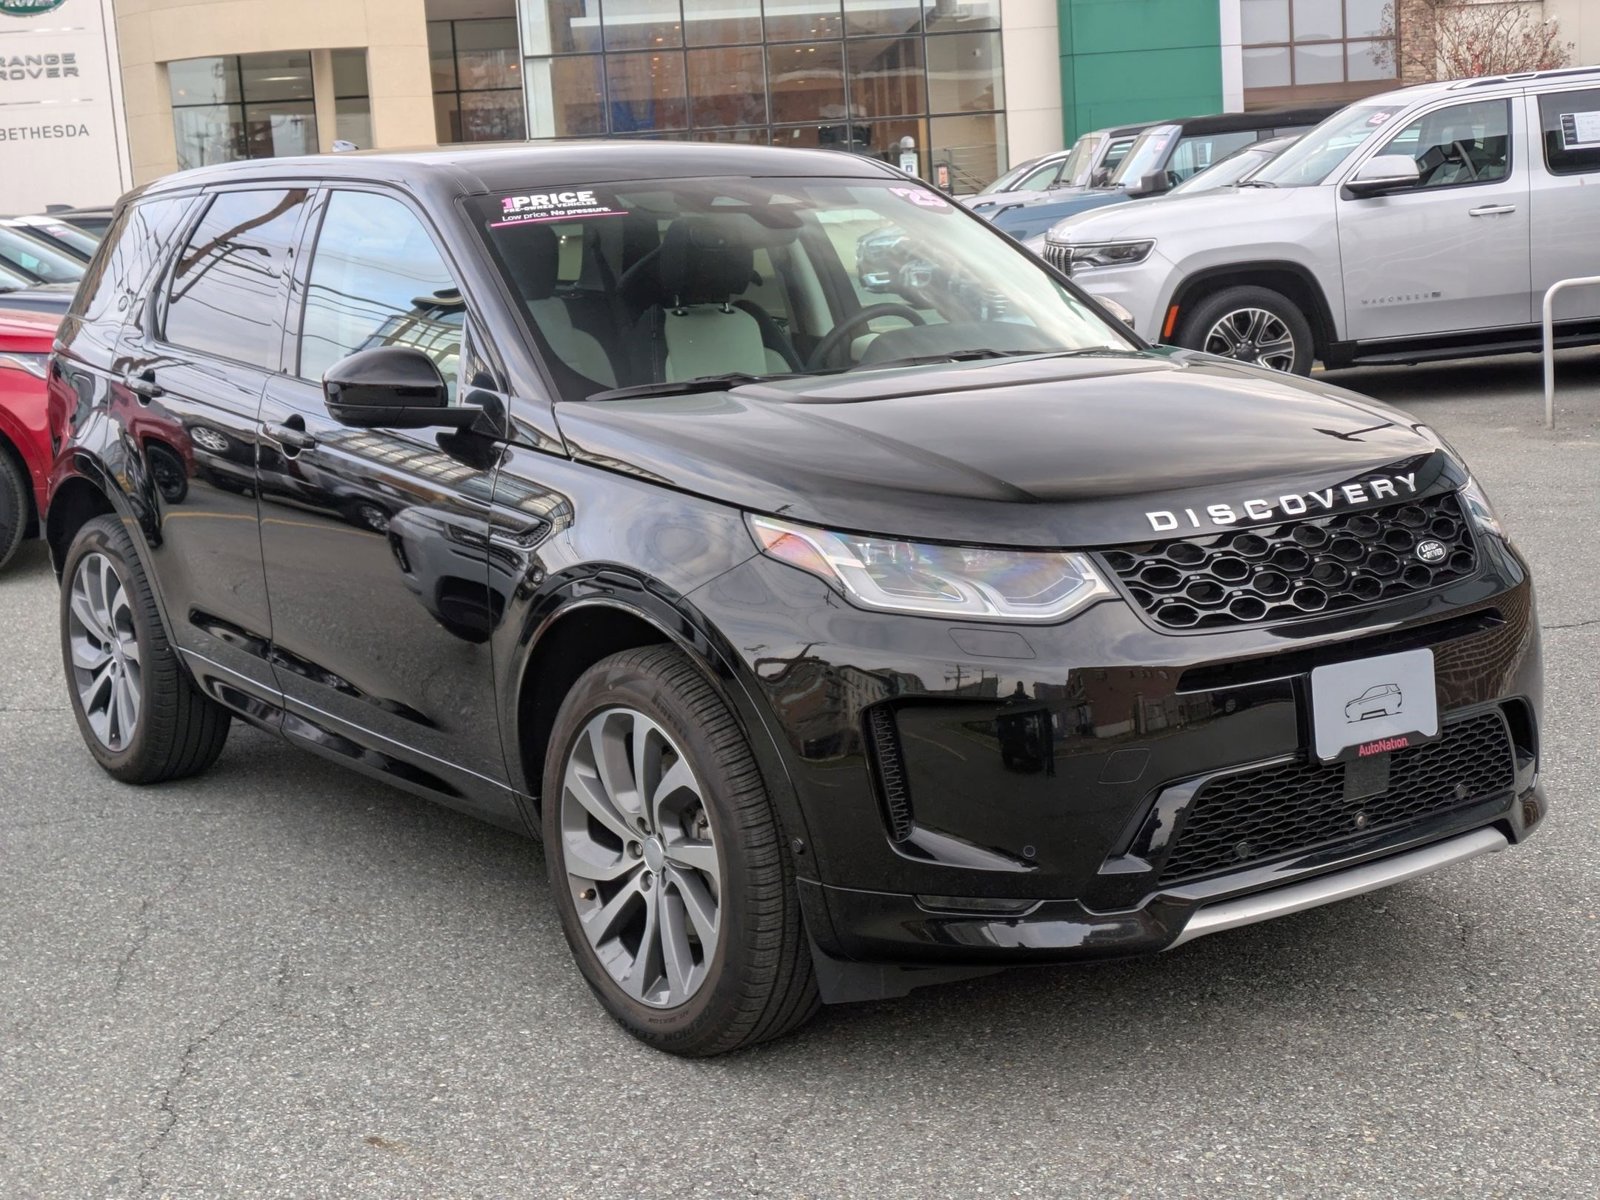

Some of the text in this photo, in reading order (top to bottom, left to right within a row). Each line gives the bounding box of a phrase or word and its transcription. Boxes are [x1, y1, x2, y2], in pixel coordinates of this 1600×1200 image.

[0, 124, 90, 140] BETHESDA
[501, 190, 596, 209] 1PRICE
[502, 214, 522, 222] Low
[523, 212, 549, 220] price.
[566, 206, 611, 215] pressure.
[1146, 473, 1418, 532] DISCOVERY
[1359, 737, 1409, 757] AutoNation
